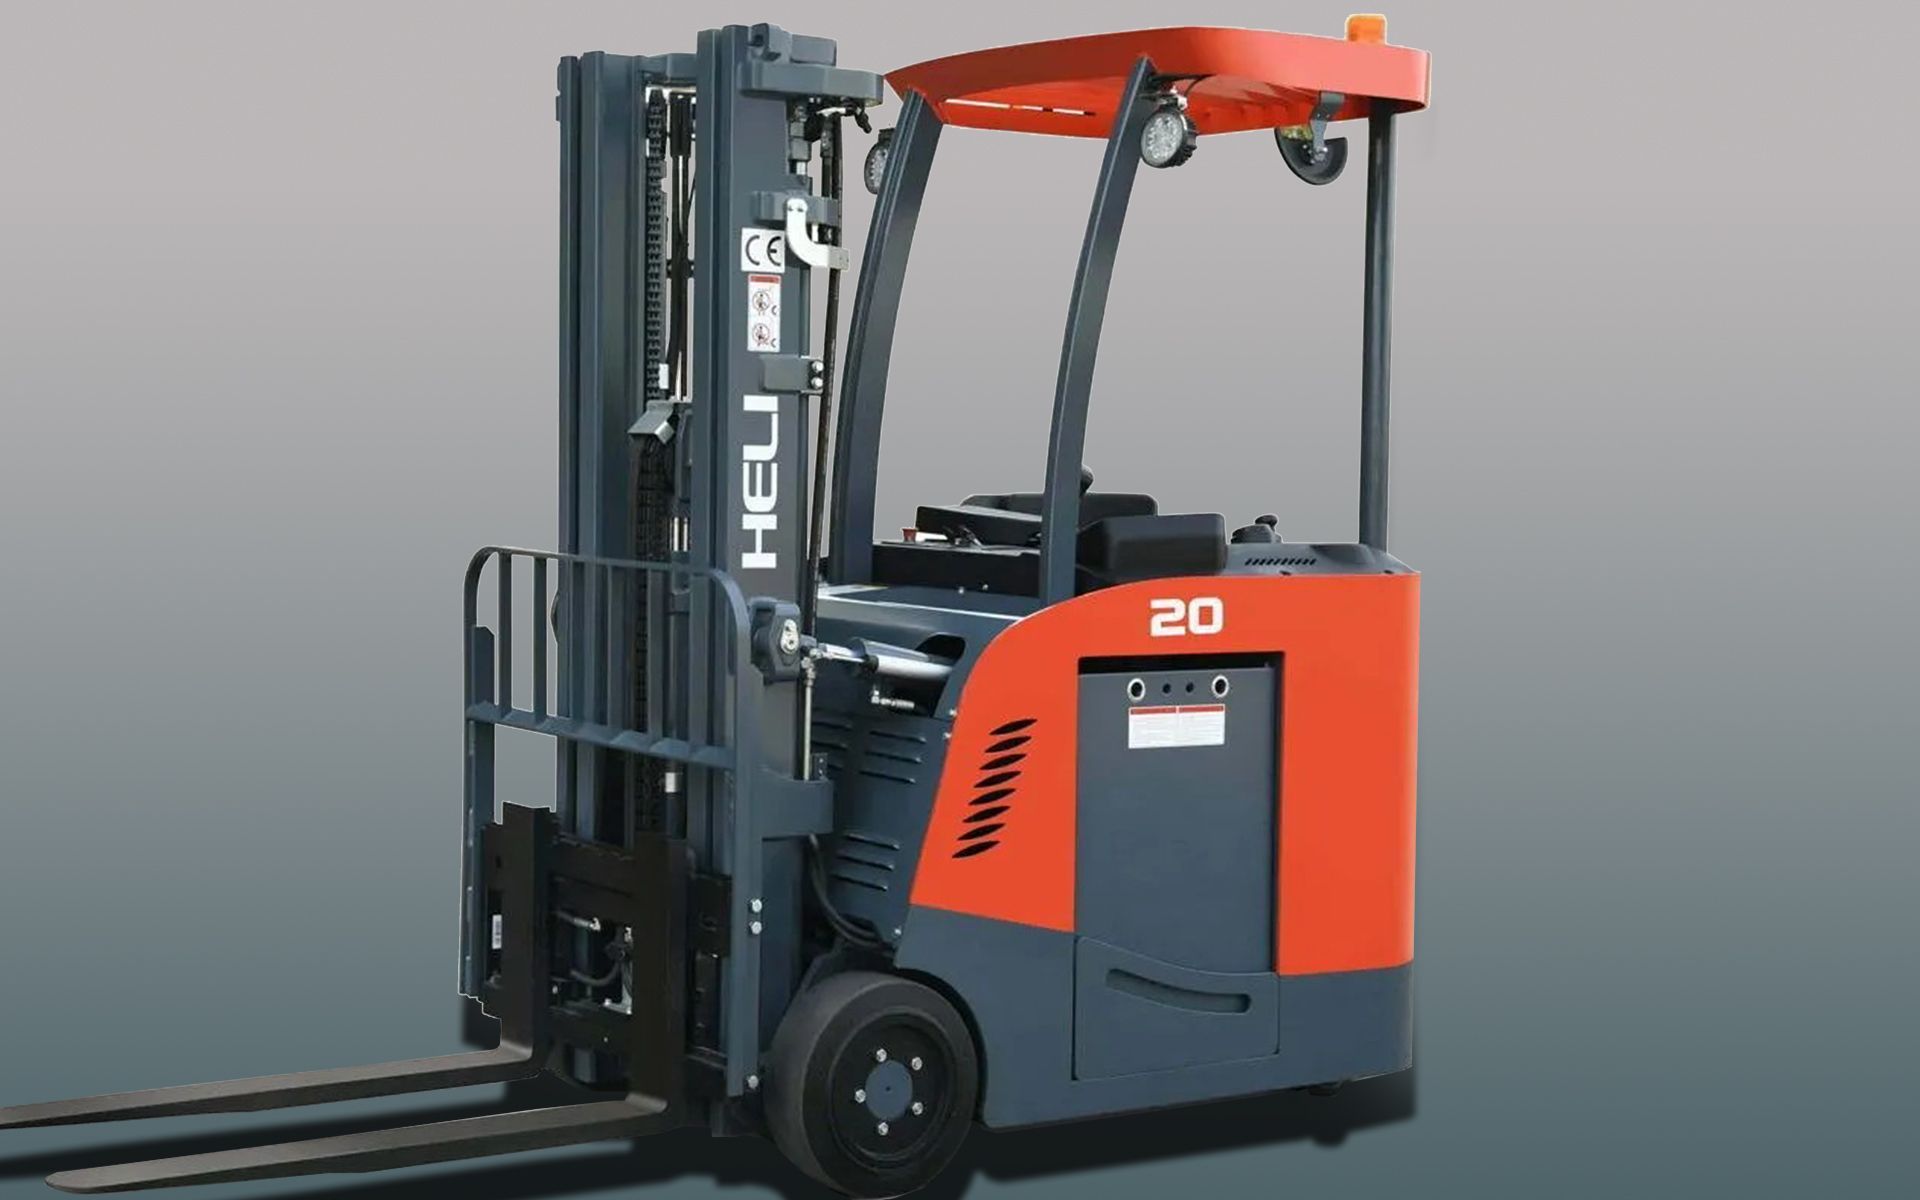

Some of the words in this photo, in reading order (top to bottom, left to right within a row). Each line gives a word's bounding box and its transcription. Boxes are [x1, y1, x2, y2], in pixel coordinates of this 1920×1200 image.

[745, 234, 782, 266] CE
[741, 394, 779, 569] HELI
[1150, 597, 1224, 637] 20
